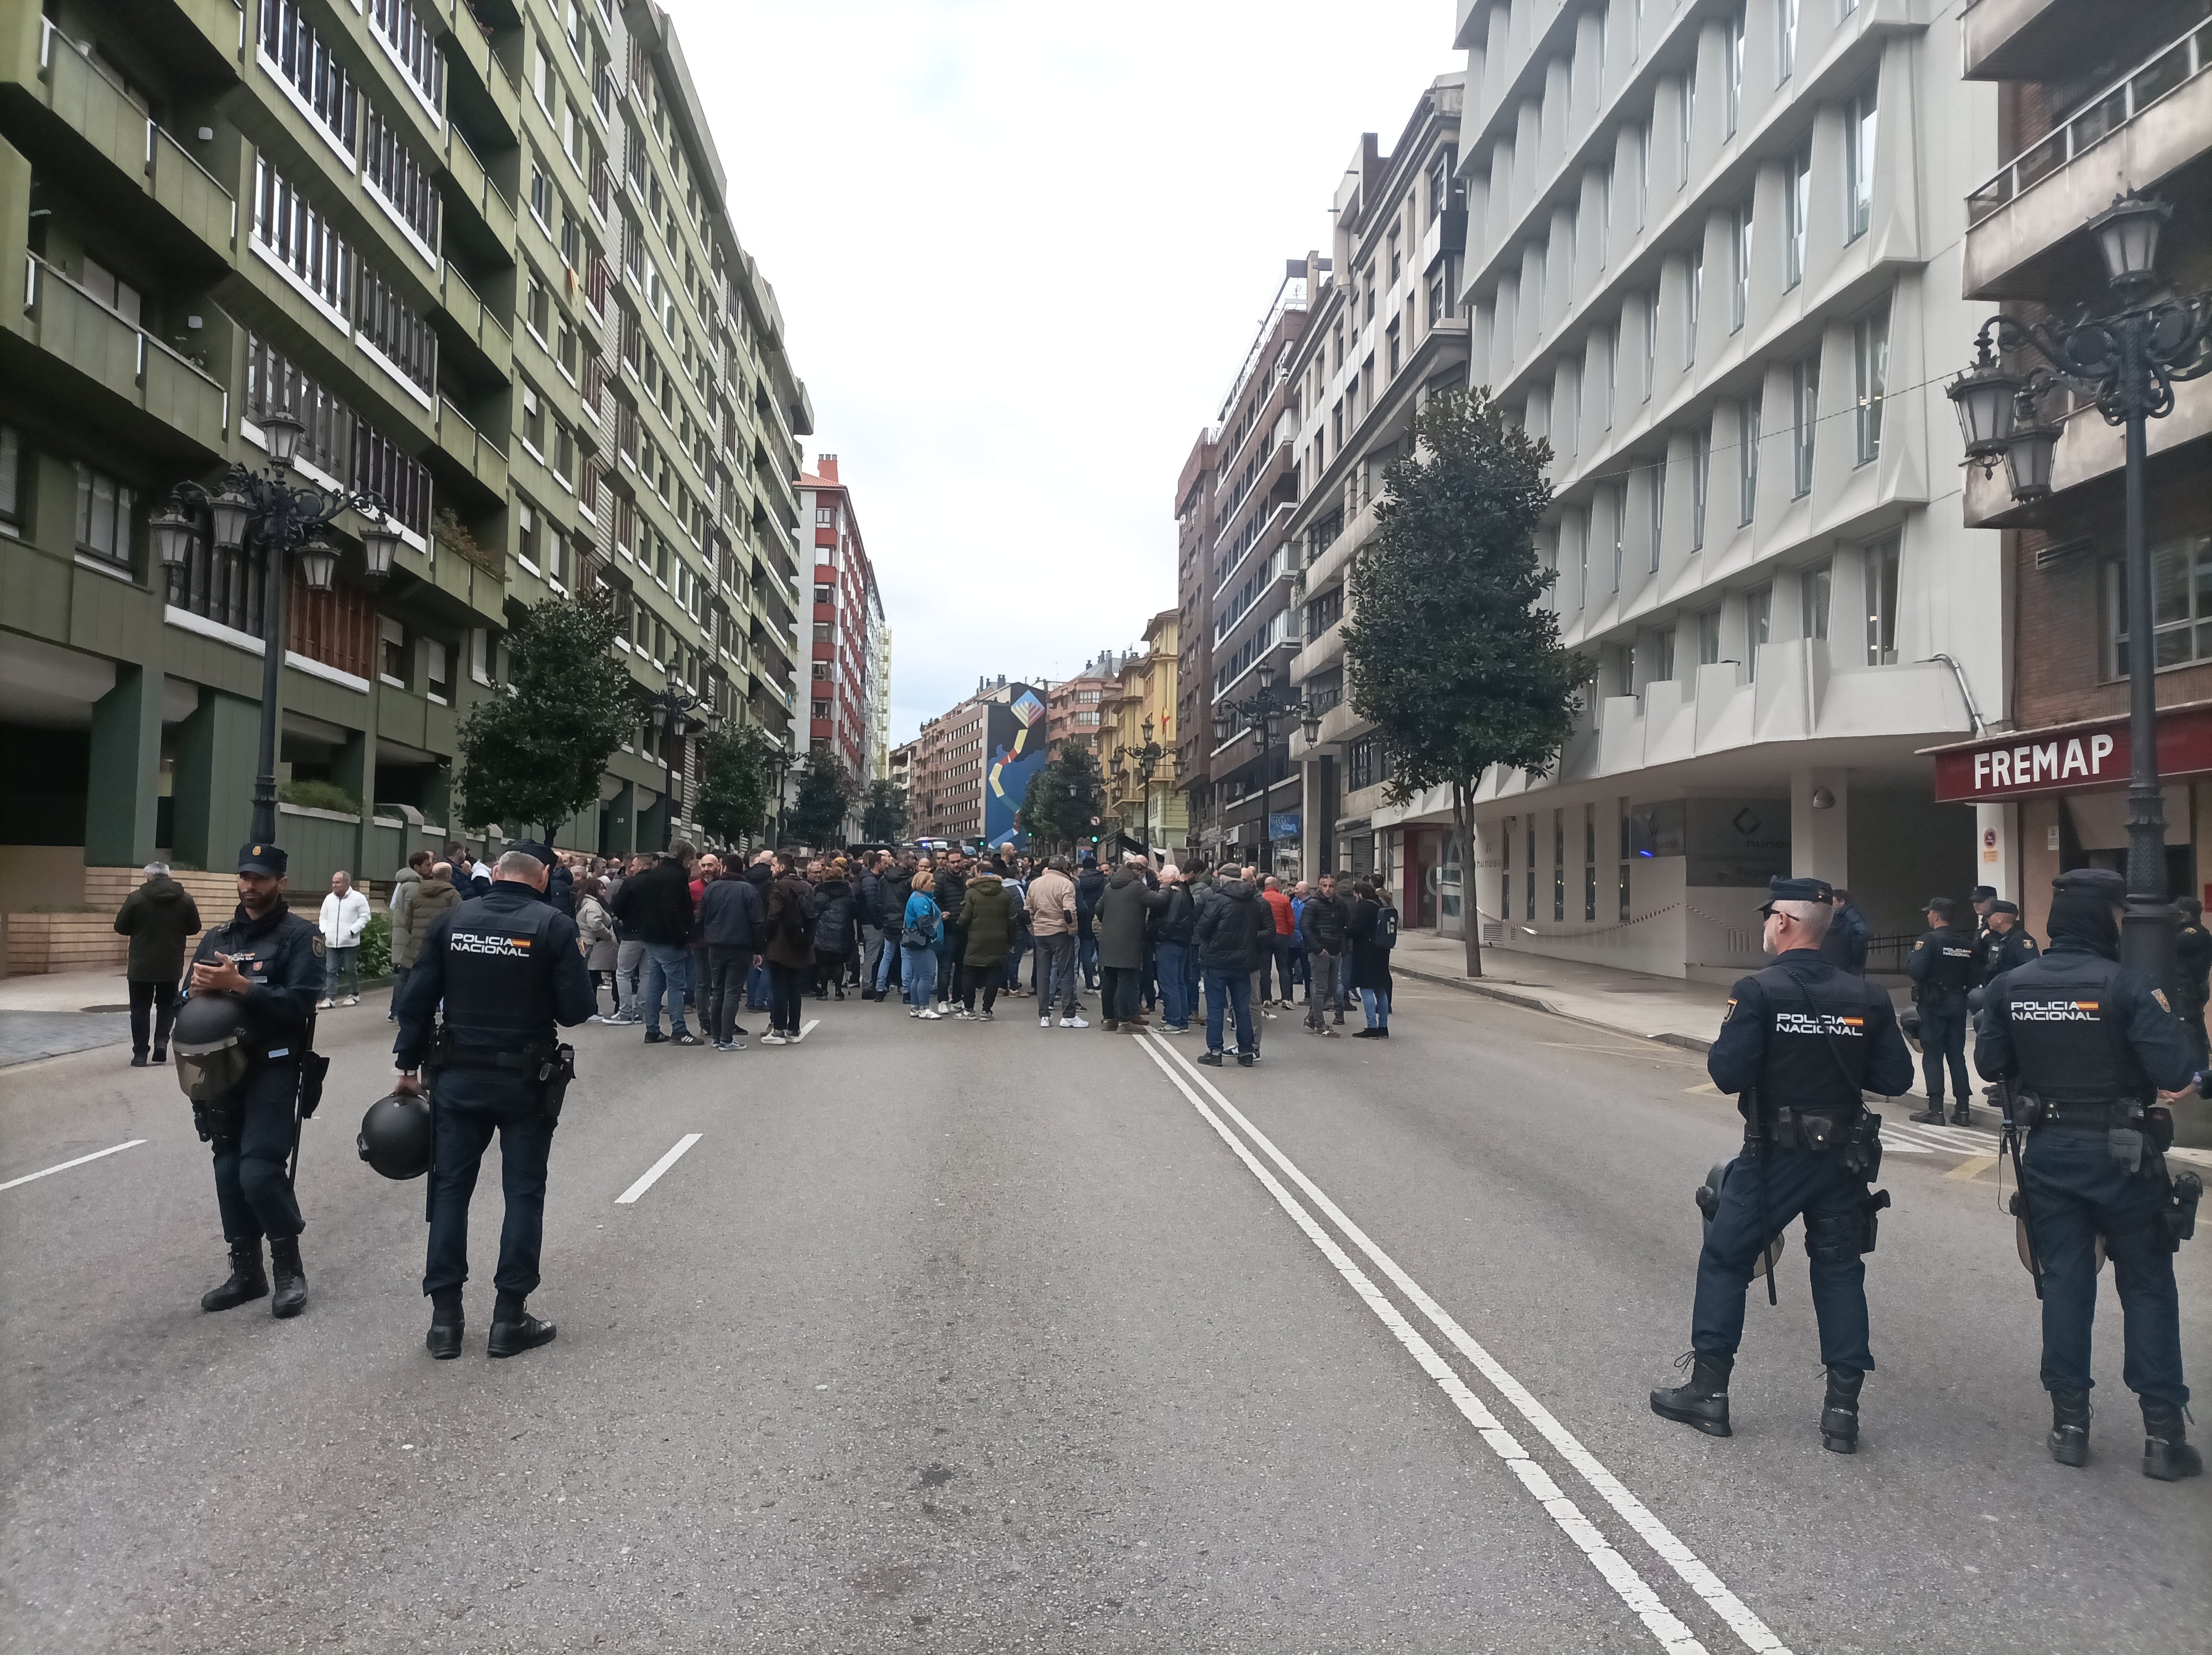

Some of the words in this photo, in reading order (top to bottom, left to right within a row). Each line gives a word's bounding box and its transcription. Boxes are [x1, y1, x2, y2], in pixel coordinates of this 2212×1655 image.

[1975, 734, 2114, 789] FREMAP
[451, 933, 514, 946] POLICIA
[450, 942, 529, 957] NACIONAL
[2011, 1001, 2080, 1011] POLICIA
[2011, 1011, 2100, 1021] NACIONAL
